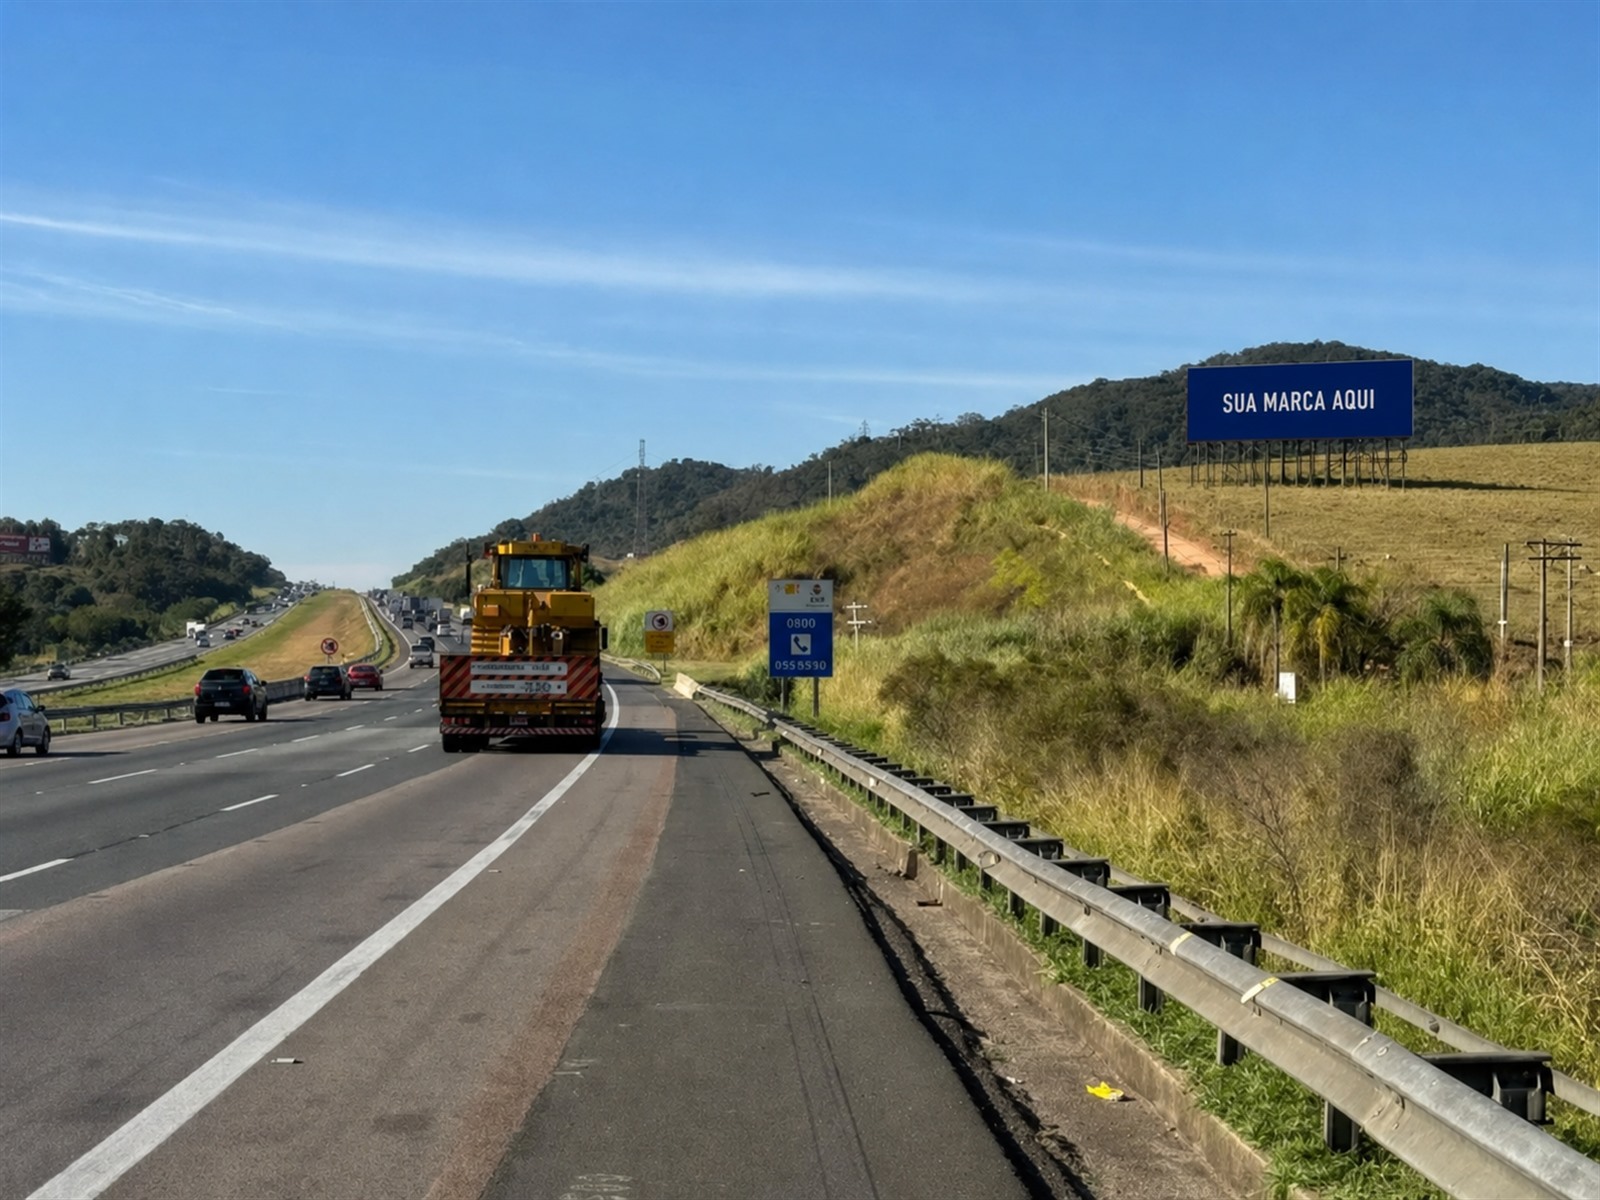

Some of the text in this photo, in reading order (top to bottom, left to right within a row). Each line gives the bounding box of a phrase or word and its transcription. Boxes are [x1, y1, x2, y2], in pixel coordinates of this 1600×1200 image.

[1222, 388, 1375, 413] SUA MARCA AQUI
[786, 618, 816, 629] 0800
